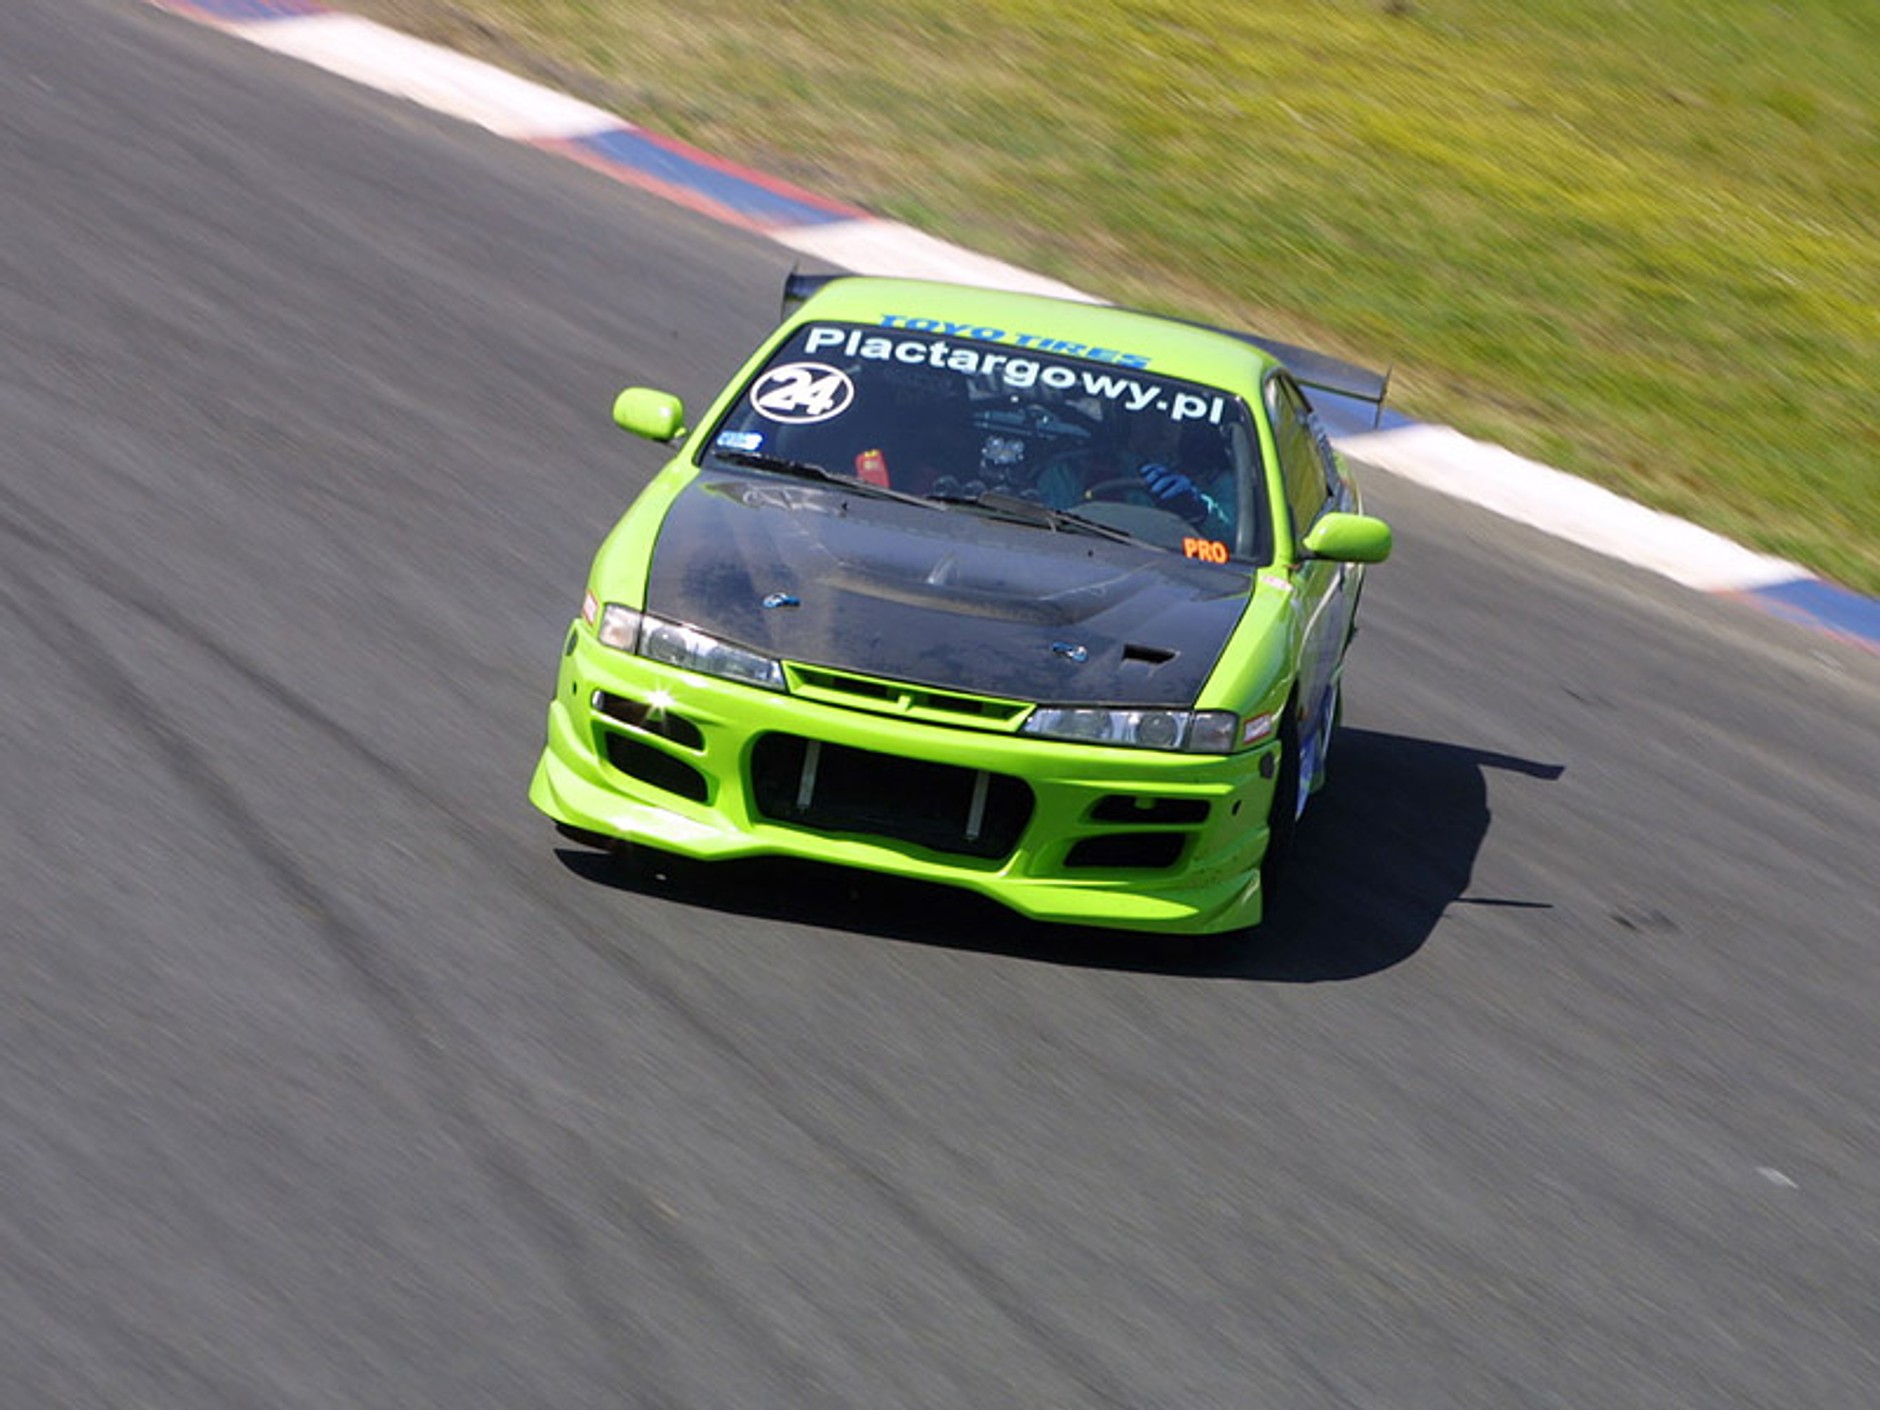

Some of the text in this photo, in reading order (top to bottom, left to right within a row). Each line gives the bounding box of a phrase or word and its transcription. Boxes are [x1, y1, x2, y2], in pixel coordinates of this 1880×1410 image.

[879, 314, 1152, 369] TOYO TIRES
[758, 368, 843, 416] 24
[804, 327, 1225, 425] Plactargowy.pl
[1182, 537, 1229, 564] PRO
